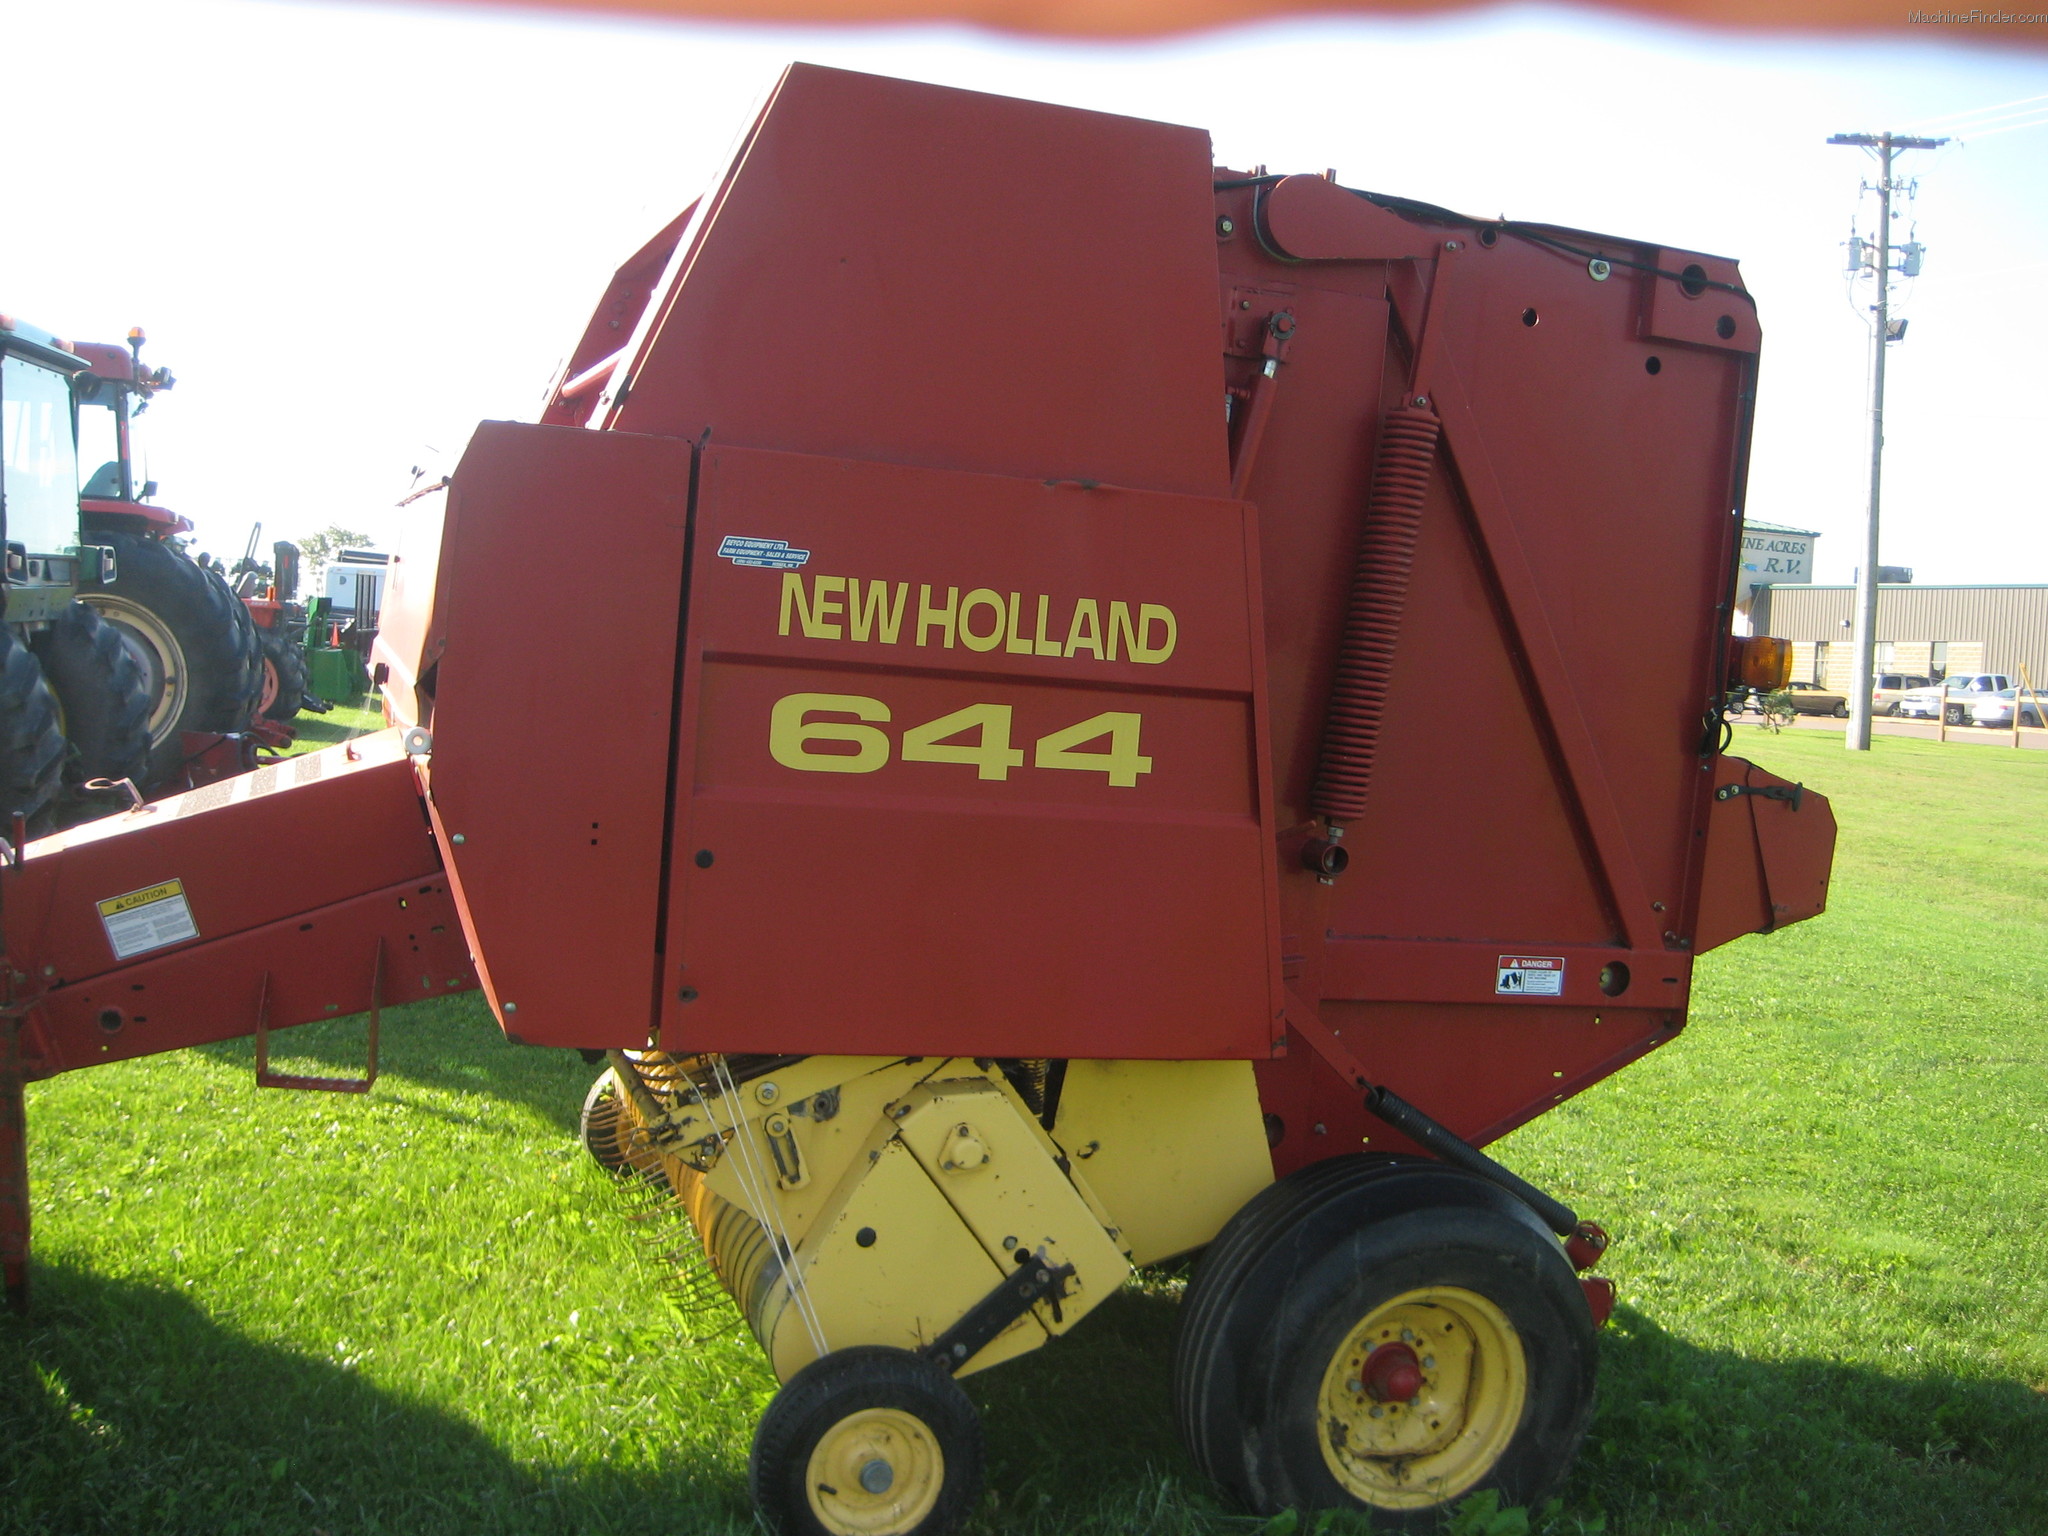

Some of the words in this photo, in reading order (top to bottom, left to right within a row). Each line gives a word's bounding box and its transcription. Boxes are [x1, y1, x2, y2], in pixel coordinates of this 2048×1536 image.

[744, 541, 774, 549] EQUIPMENT
[1765, 541, 1806, 555] ACRES
[1763, 558, 1801, 575] R.V.
[778, 572, 909, 644] NEW
[916, 584, 1178, 664] HOLLAND
[769, 692, 1153, 787] 644
[126, 888, 167, 906] CAUTION
